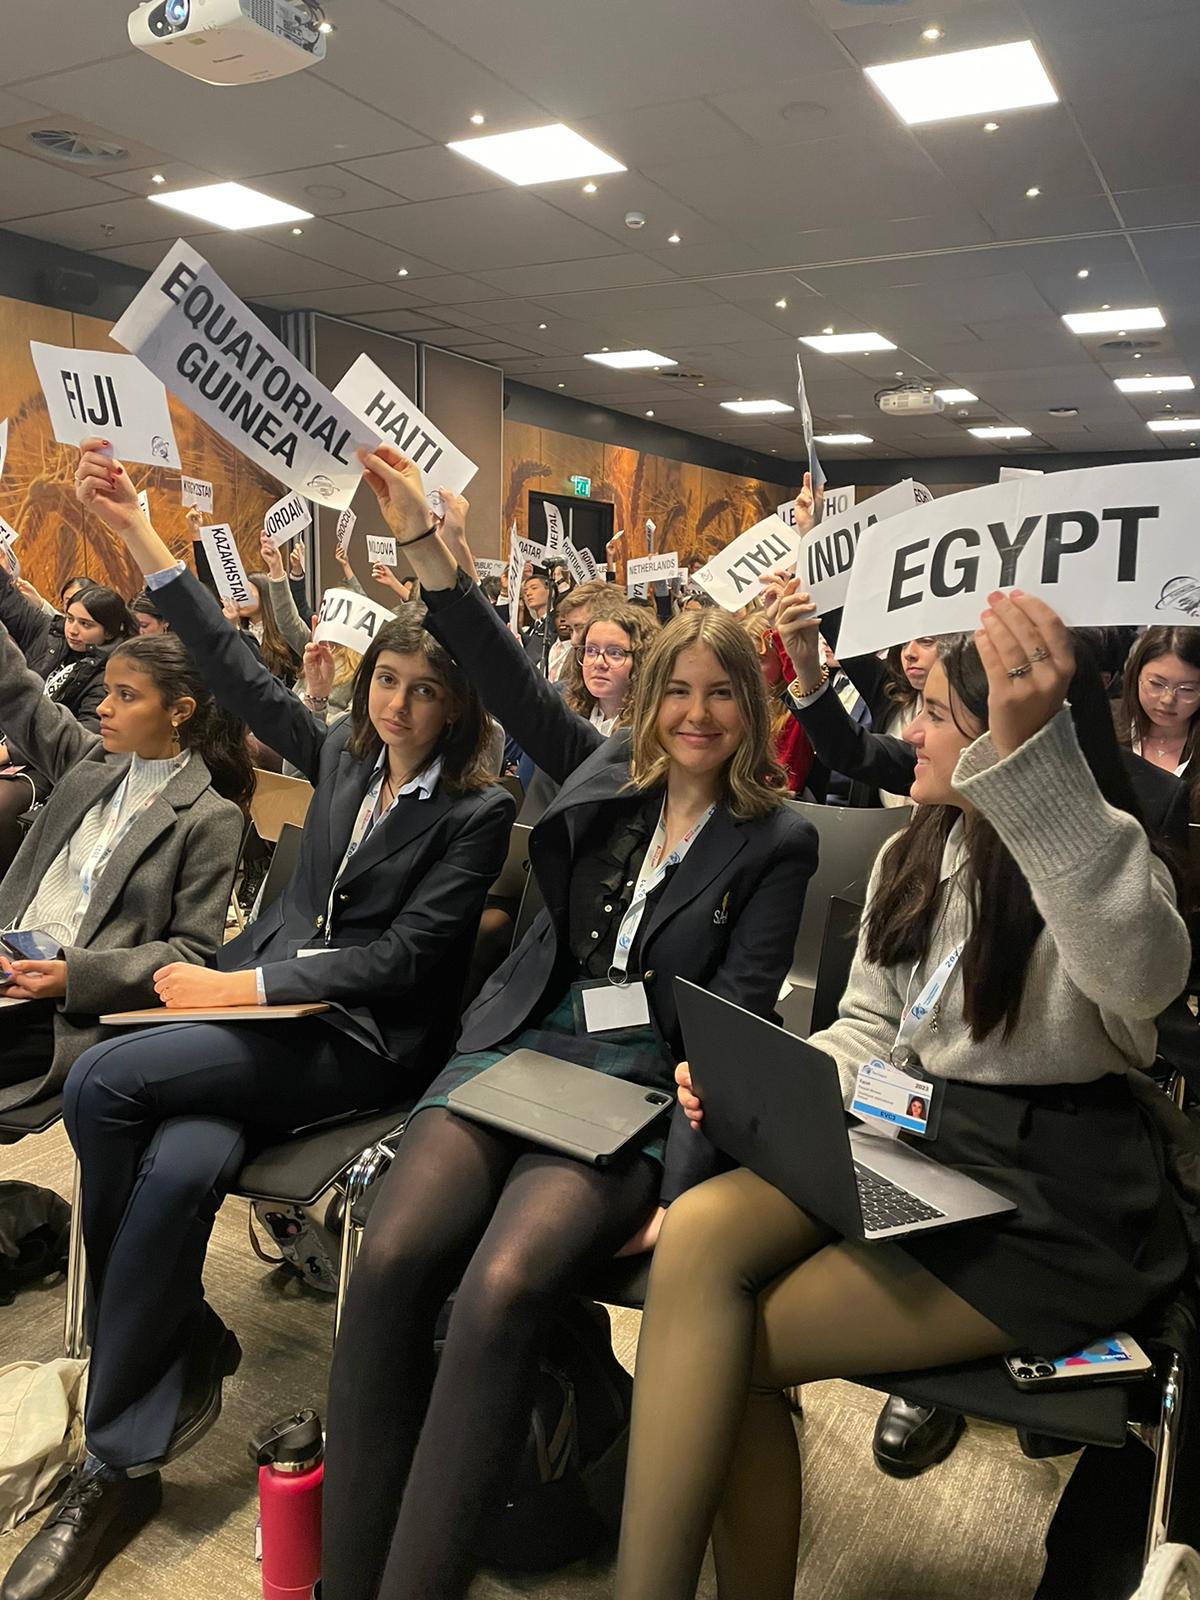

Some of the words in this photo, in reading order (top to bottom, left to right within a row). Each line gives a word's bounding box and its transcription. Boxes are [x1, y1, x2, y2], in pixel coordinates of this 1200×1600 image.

[160, 261, 352, 466] EQUATORIAL
[60, 369, 123, 428] FIJI
[176, 342, 297, 469] GUINEA
[364, 390, 443, 474] HAITI
[265, 496, 304, 538] JORDAN
[548, 513, 559, 550] NEPAL
[211, 528, 249, 604] KAZAKHSTAN
[368, 540, 394, 556] MOLDOVA
[518, 541, 542, 560] QATAR
[629, 559, 676, 575] NETHERLANDS
[726, 533, 792, 594] ITALY
[886, 505, 1160, 613] EGYPT
